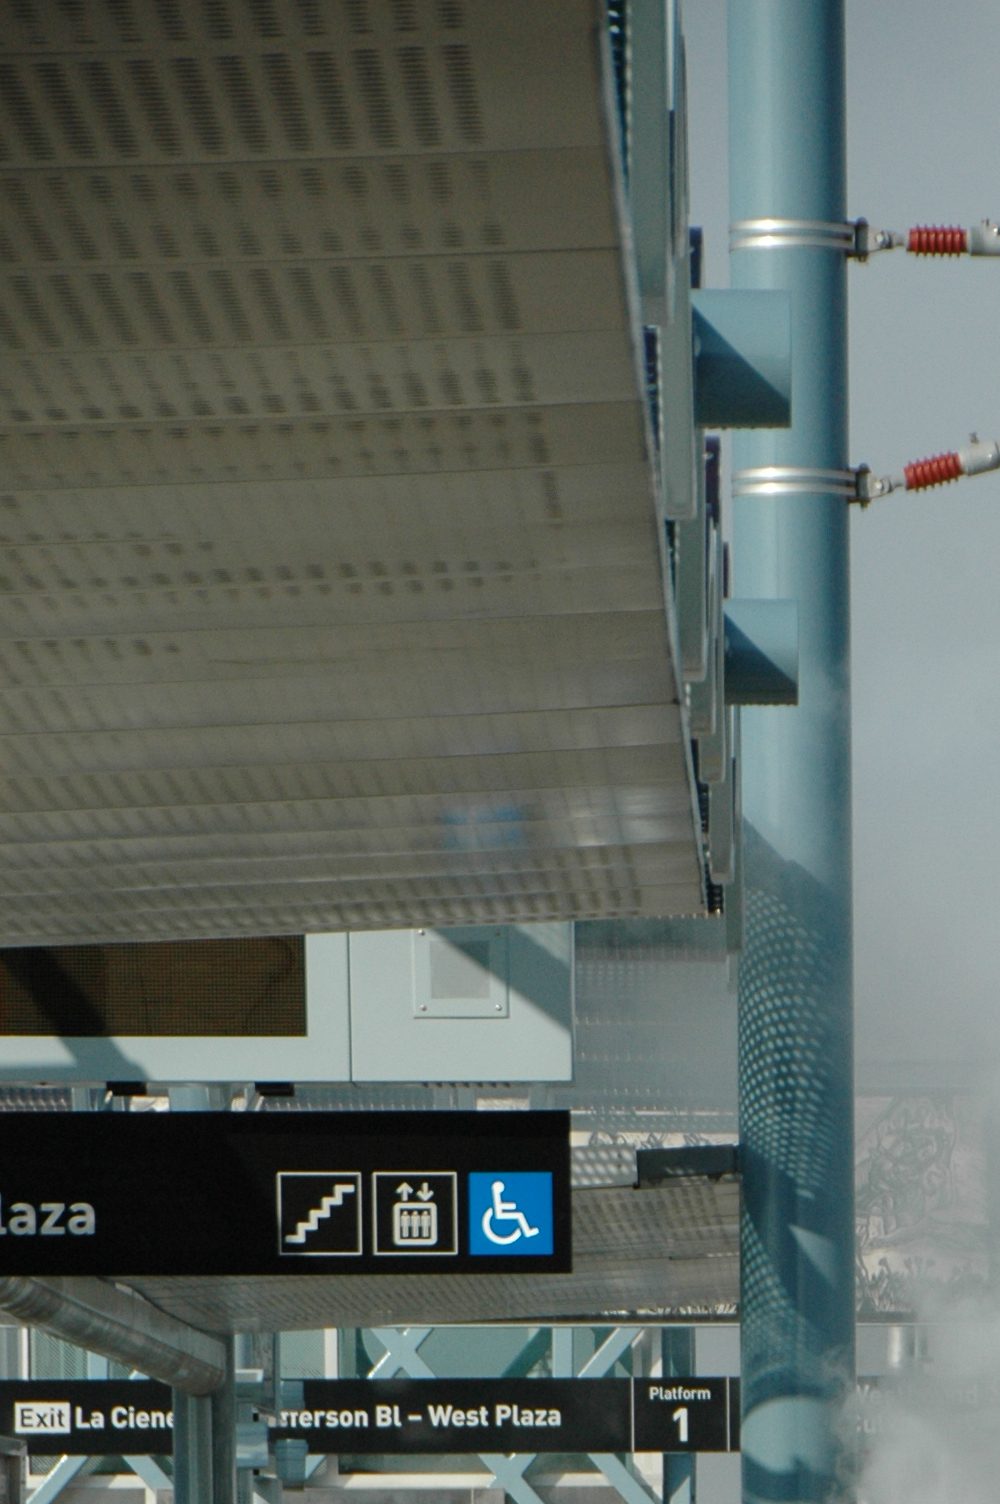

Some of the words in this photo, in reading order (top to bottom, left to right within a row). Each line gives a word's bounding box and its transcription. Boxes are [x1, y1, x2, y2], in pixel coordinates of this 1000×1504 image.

[649, 1386, 712, 1400] Platform
[20, 1407, 66, 1428] Exit
[75, 1405, 105, 1428] La
[375, 1404, 402, 1428] Bl
[427, 1404, 489, 1427] West
[496, 1404, 562, 1427] Plaza
[672, 1407, 688, 1442] 1
